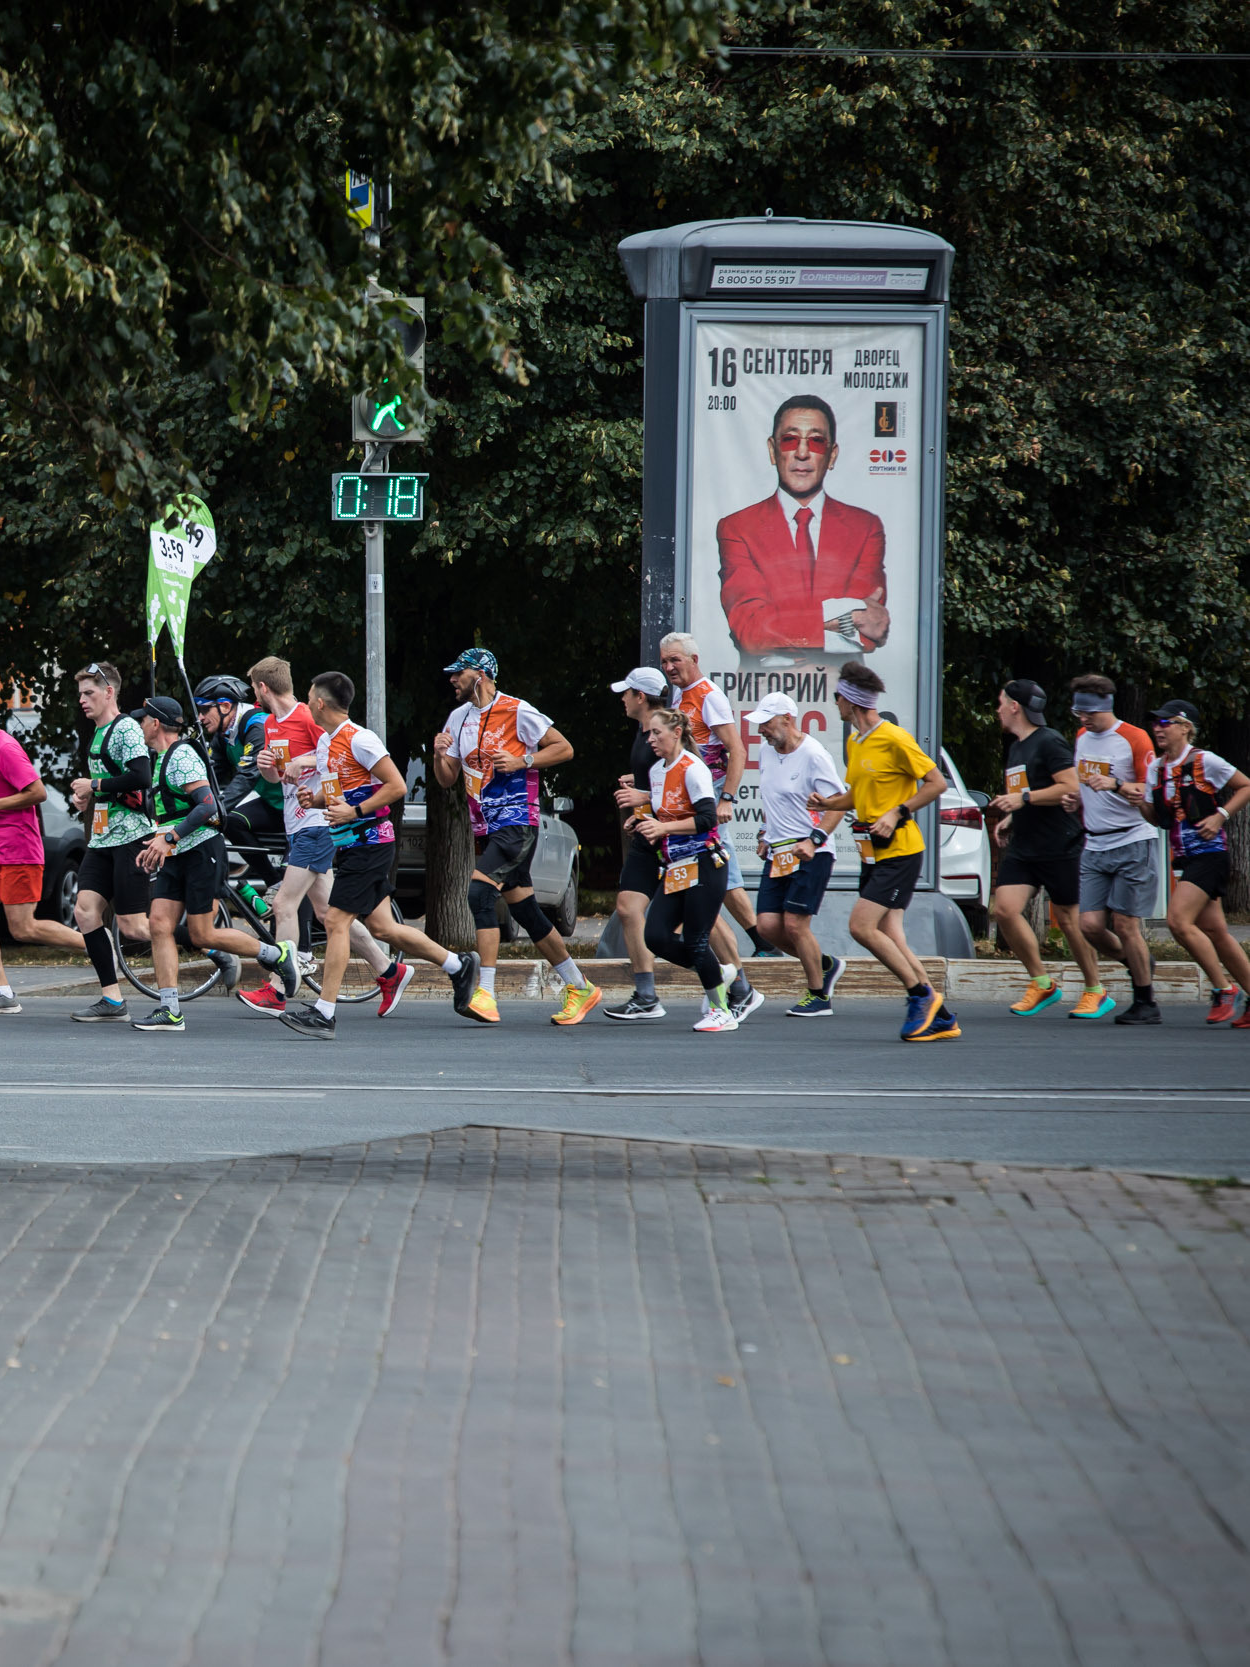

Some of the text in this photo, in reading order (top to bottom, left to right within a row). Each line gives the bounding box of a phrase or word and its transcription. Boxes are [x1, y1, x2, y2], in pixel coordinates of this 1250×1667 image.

[718, 276, 796, 284] 8 800 50 55 917
[801, 272, 860, 282] СОЛНЕЧНЫЙ
[862, 273, 885, 283] КРУГ
[854, 349, 900, 368] ДВОРЕЦ
[708, 347, 833, 387] 16 СЕНТЯБРЯ
[844, 372, 909, 390] МОЛОДЕЖИ
[708, 395, 737, 410] 20:00
[1085, 763, 1102, 775] 146
[324, 775, 336, 794] 126
[674, 867, 688, 880] 53
